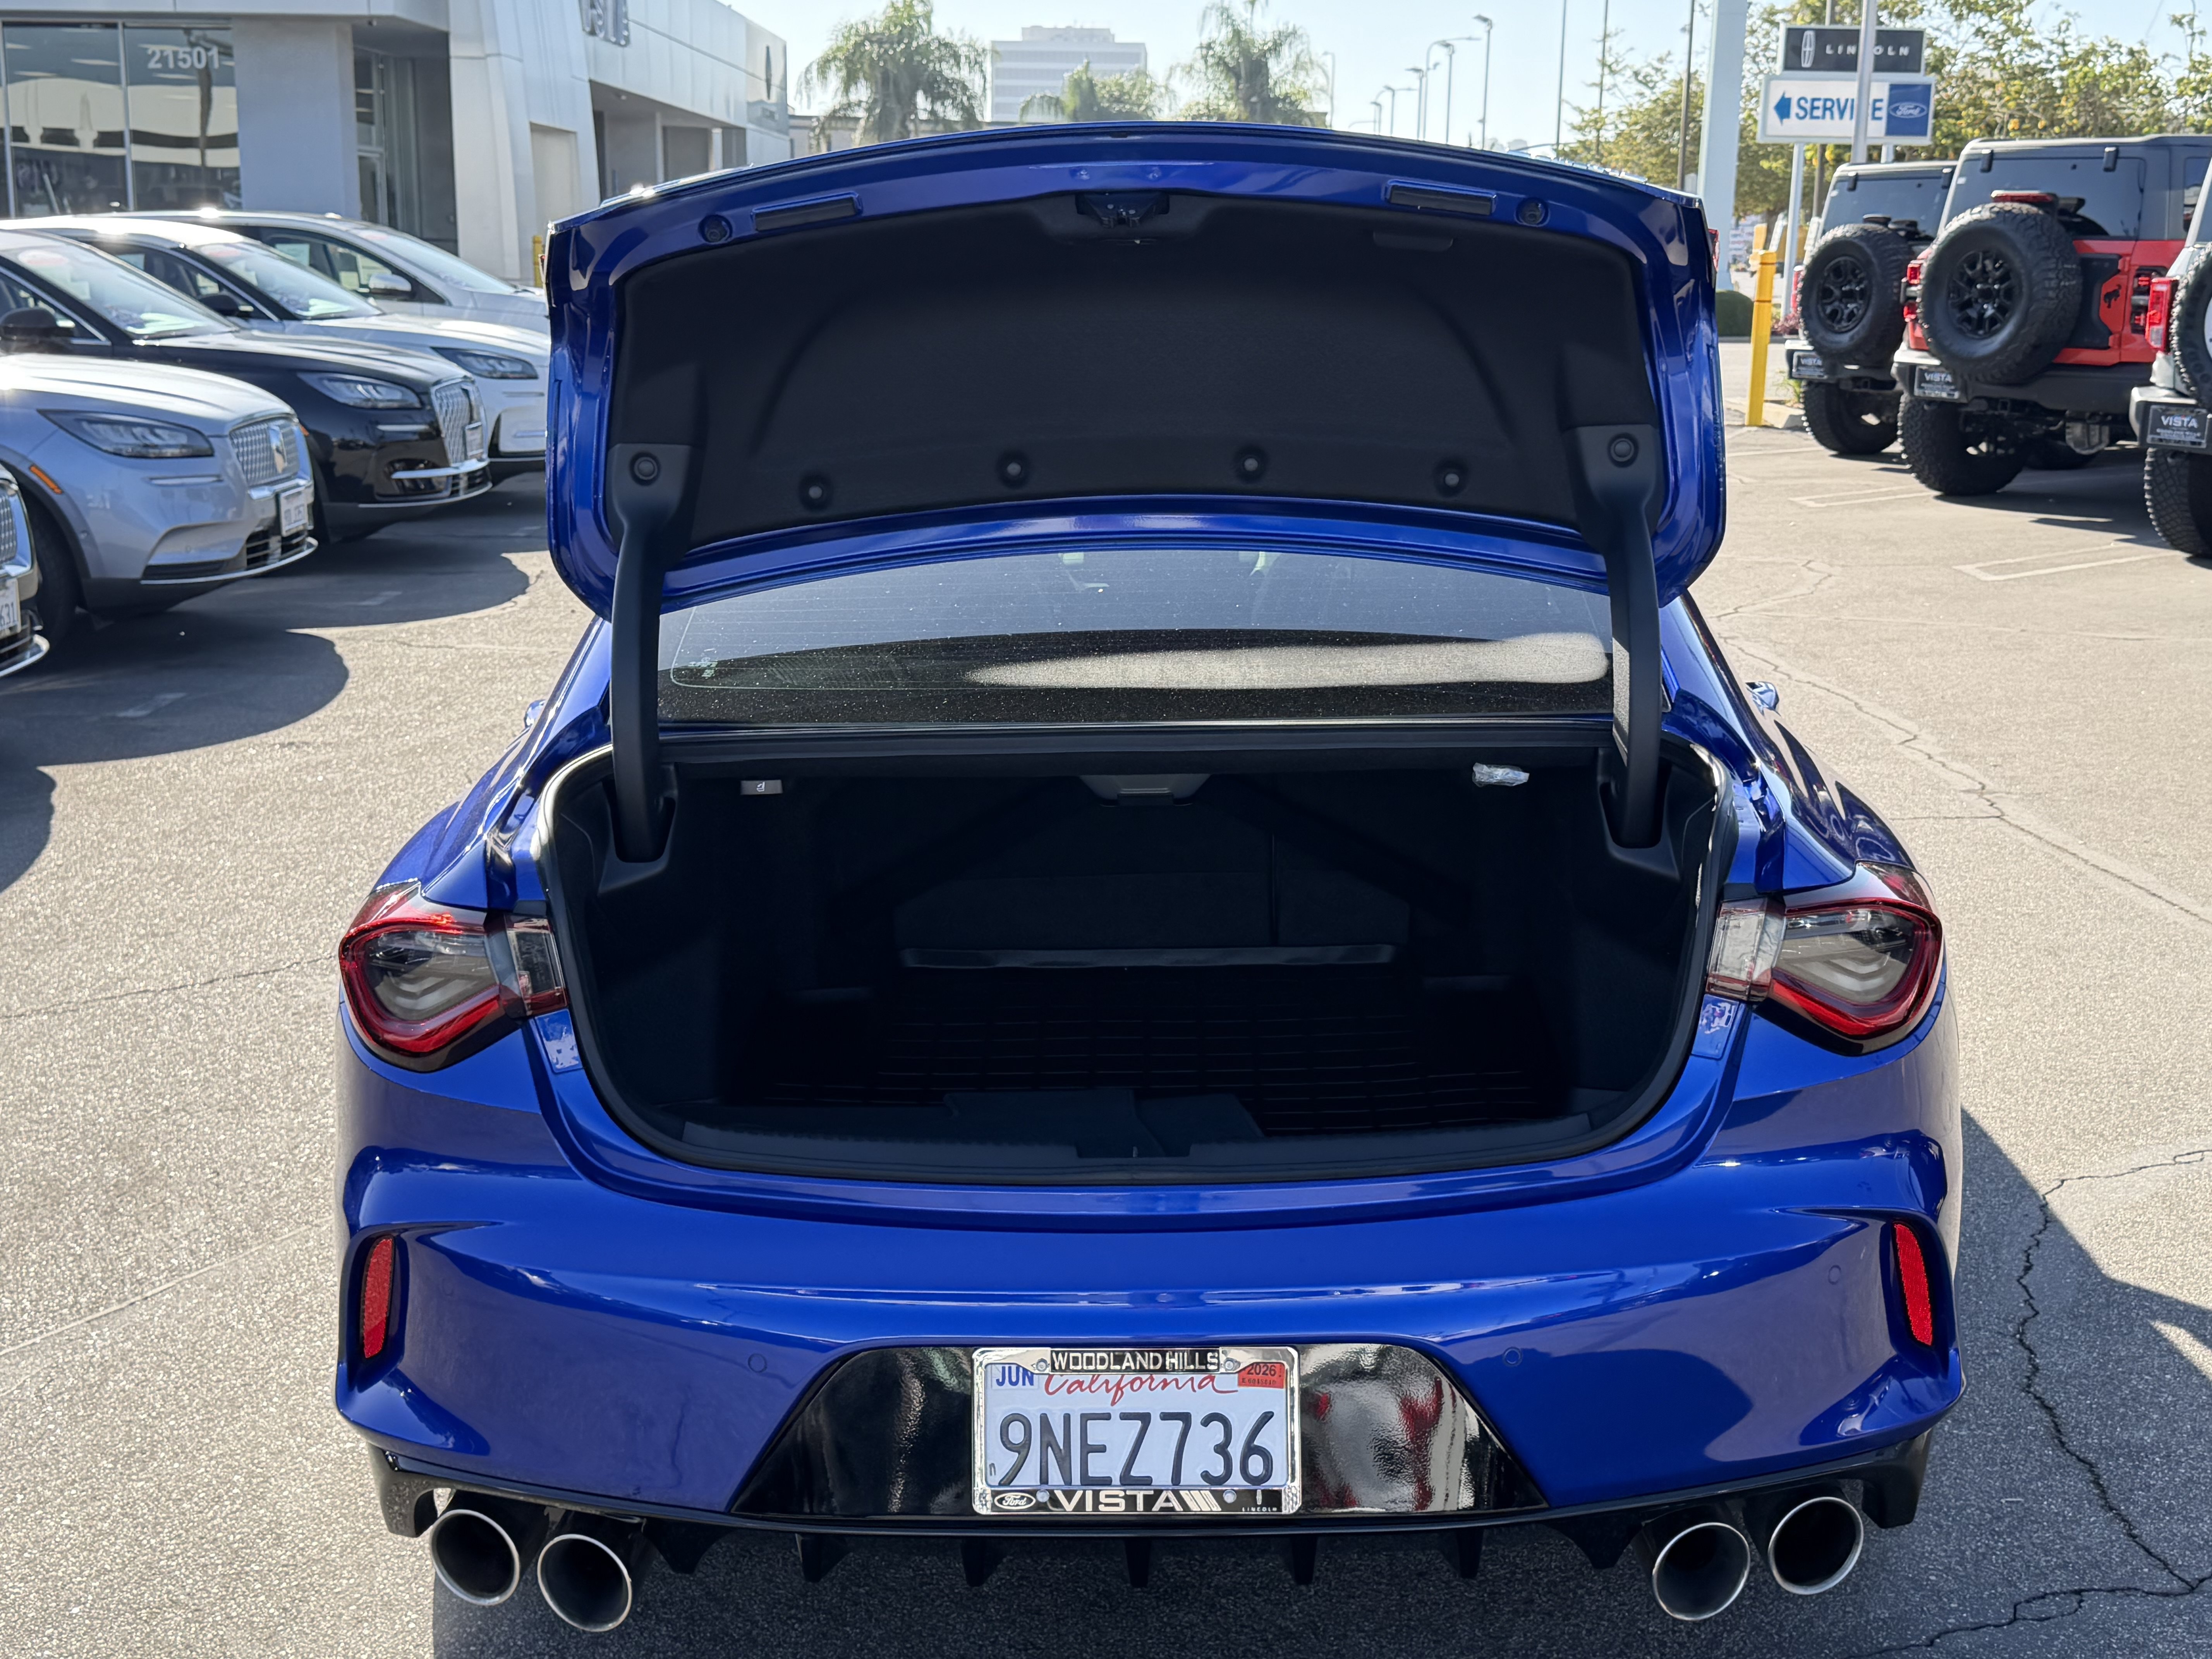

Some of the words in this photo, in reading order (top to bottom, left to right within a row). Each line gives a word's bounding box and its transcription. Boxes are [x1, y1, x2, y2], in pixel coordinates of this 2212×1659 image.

[147, 46, 219, 69] 21501
[1826, 44, 1910, 56] LINOLN
[1795, 96, 1884, 121] SERVIE
[1896, 104, 1921, 115] Ford
[1924, 372, 1952, 382] VISTA
[2161, 416, 2198, 428] VISTA
[1052, 1352, 1162, 1370] WOODLAND
[1166, 1352, 1218, 1370] HILLS
[996, 1365, 1034, 1386] JUN
[1247, 1364, 1277, 1377] 2026
[1044, 1374, 1238, 1407] California
[998, 1411, 1274, 1486] 9NEZ736
[1002, 1495, 1027, 1506] Ford
[1054, 1490, 1183, 1511] VISTA
